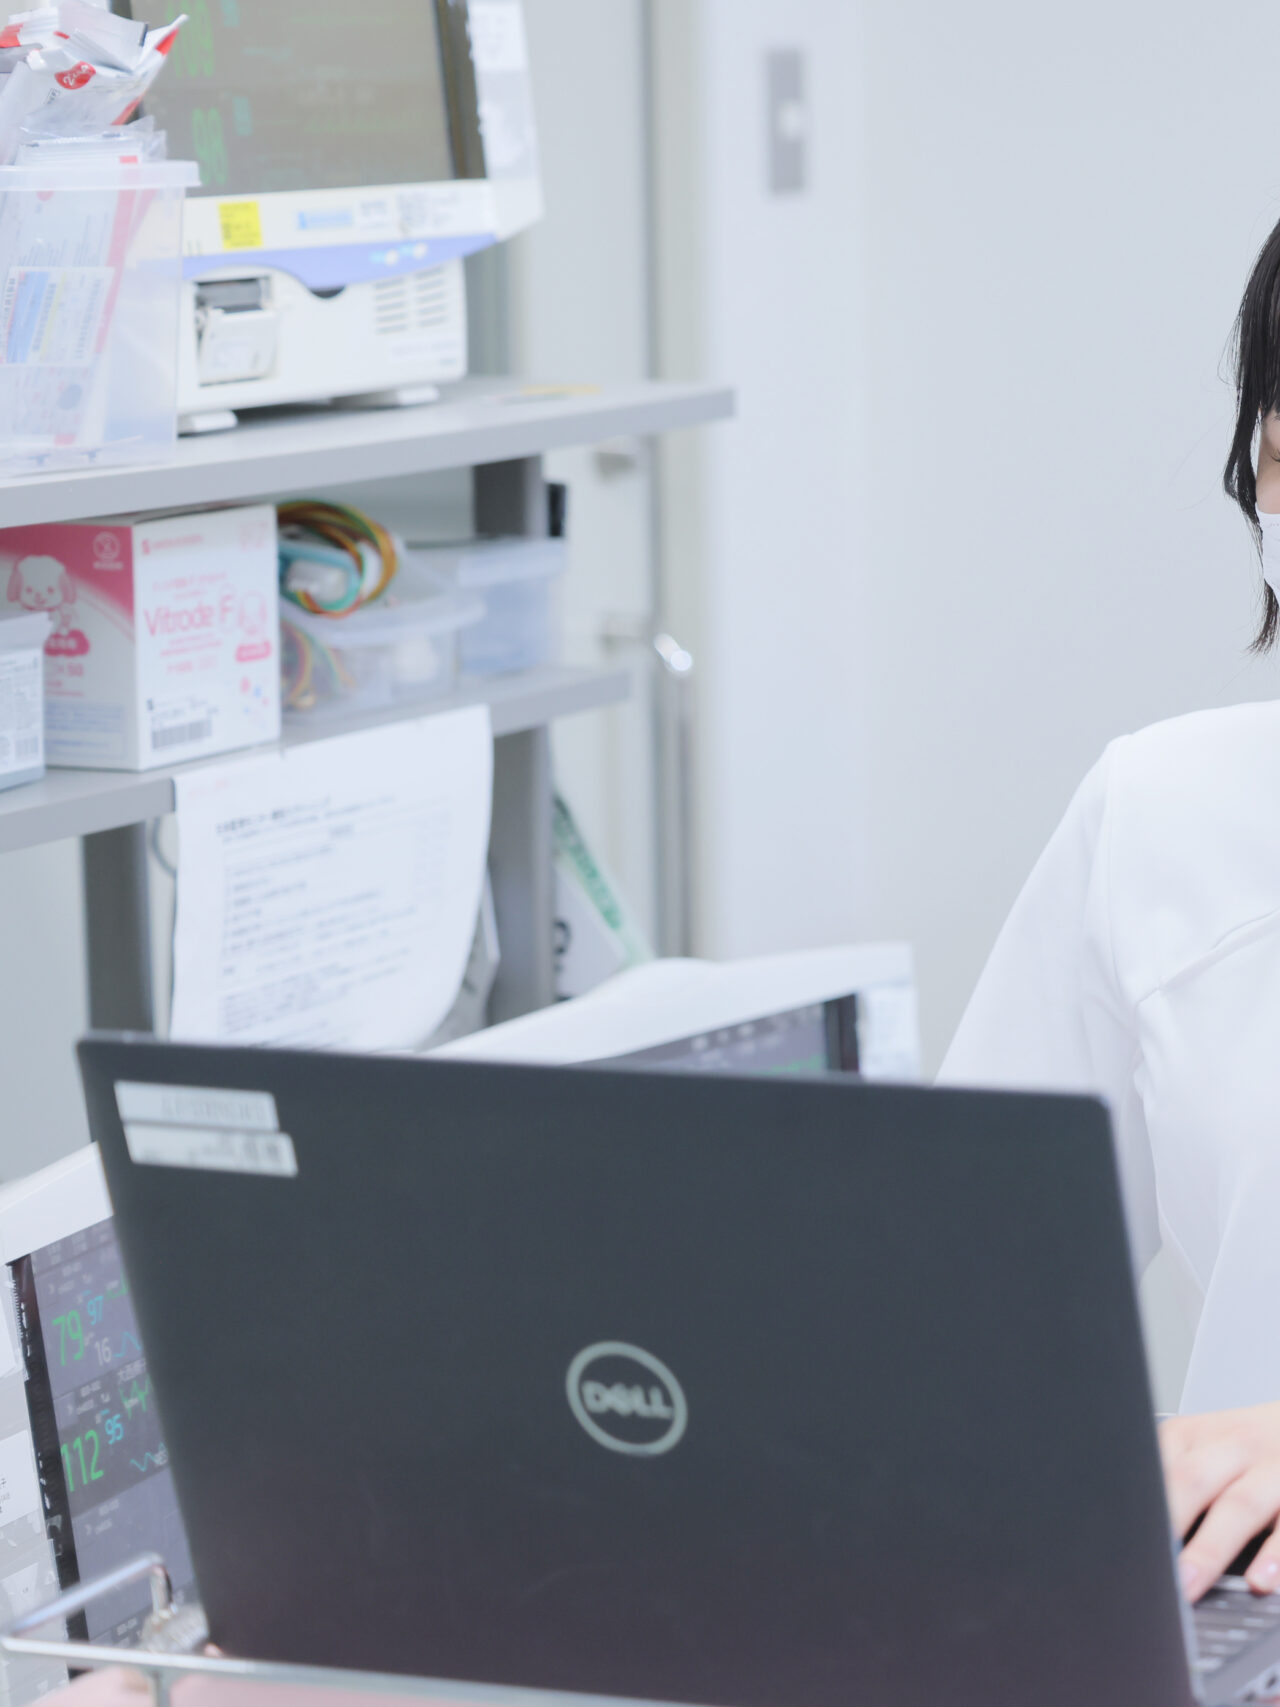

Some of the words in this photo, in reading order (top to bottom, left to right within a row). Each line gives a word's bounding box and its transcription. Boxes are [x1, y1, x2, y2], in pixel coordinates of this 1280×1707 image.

[86, 1295, 104, 1326] 97
[52, 1309, 85, 1367] 79
[94, 1337, 112, 1366] 16
[582, 1380, 673, 1420] DELL
[104, 1413, 124, 1445] 95
[60, 1429, 105, 1493] 112
